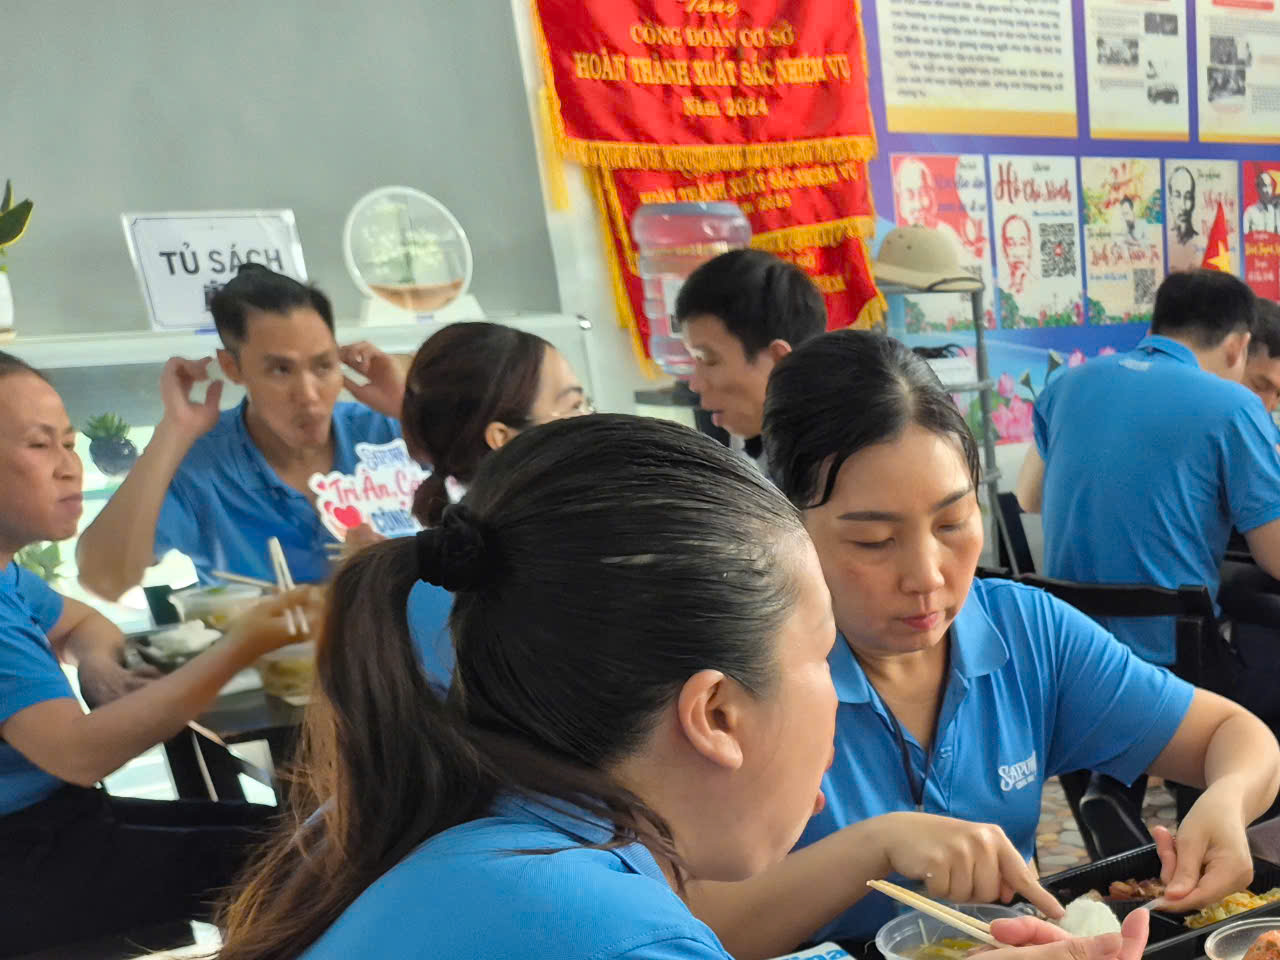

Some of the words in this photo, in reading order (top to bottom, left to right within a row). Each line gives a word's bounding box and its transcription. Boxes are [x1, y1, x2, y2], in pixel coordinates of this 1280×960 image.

[631, 21, 683, 46] CÔNG
[574, 47, 627, 81] HOÀN
[630, 49, 690, 86] THÀNH
[725, 96, 769, 118] 2024
[159, 242, 200, 275] TỦ
[209, 244, 283, 274] SÁCH
